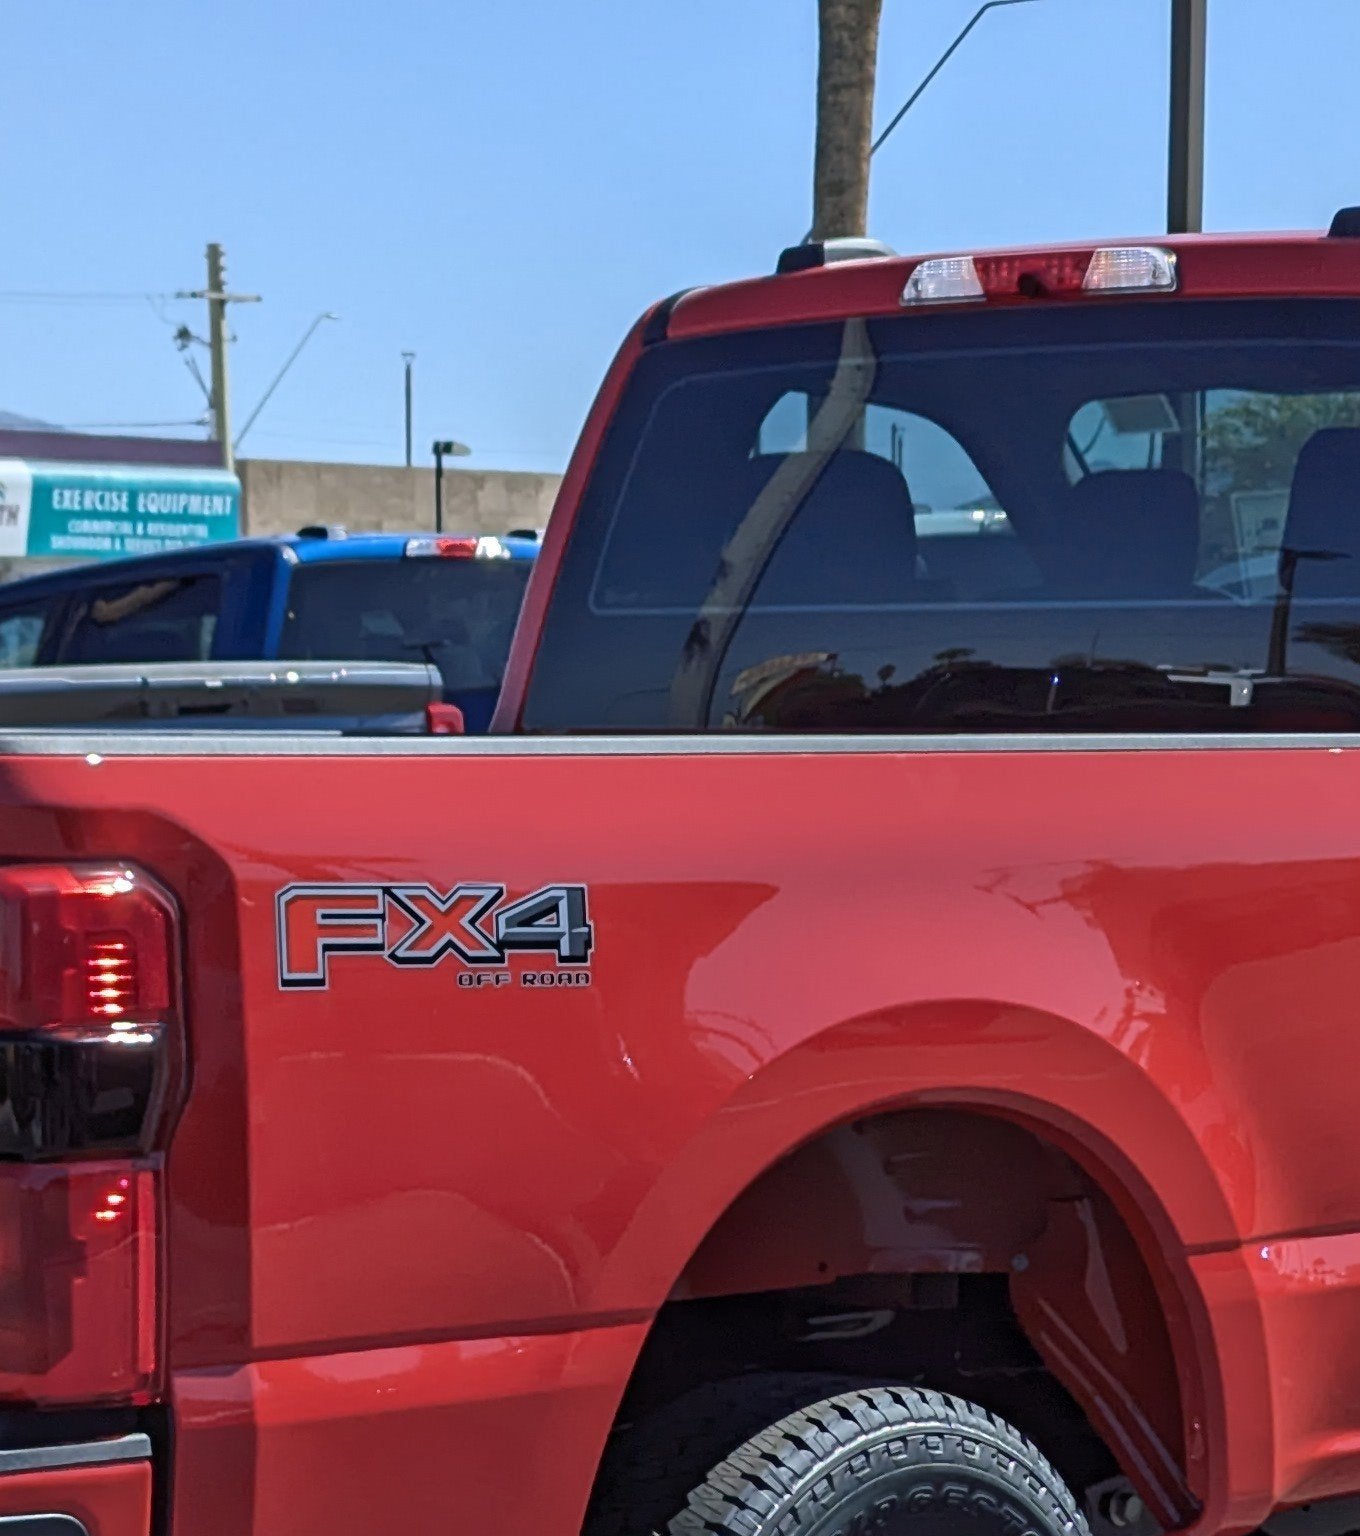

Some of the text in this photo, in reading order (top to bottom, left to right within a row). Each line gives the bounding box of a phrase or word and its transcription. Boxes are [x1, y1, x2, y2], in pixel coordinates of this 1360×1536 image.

[51, 488, 233, 517] EXERCISE EQUIPMENT
[274, 882, 595, 992] FX4
[457, 971, 592, 988] OFF ROAD
